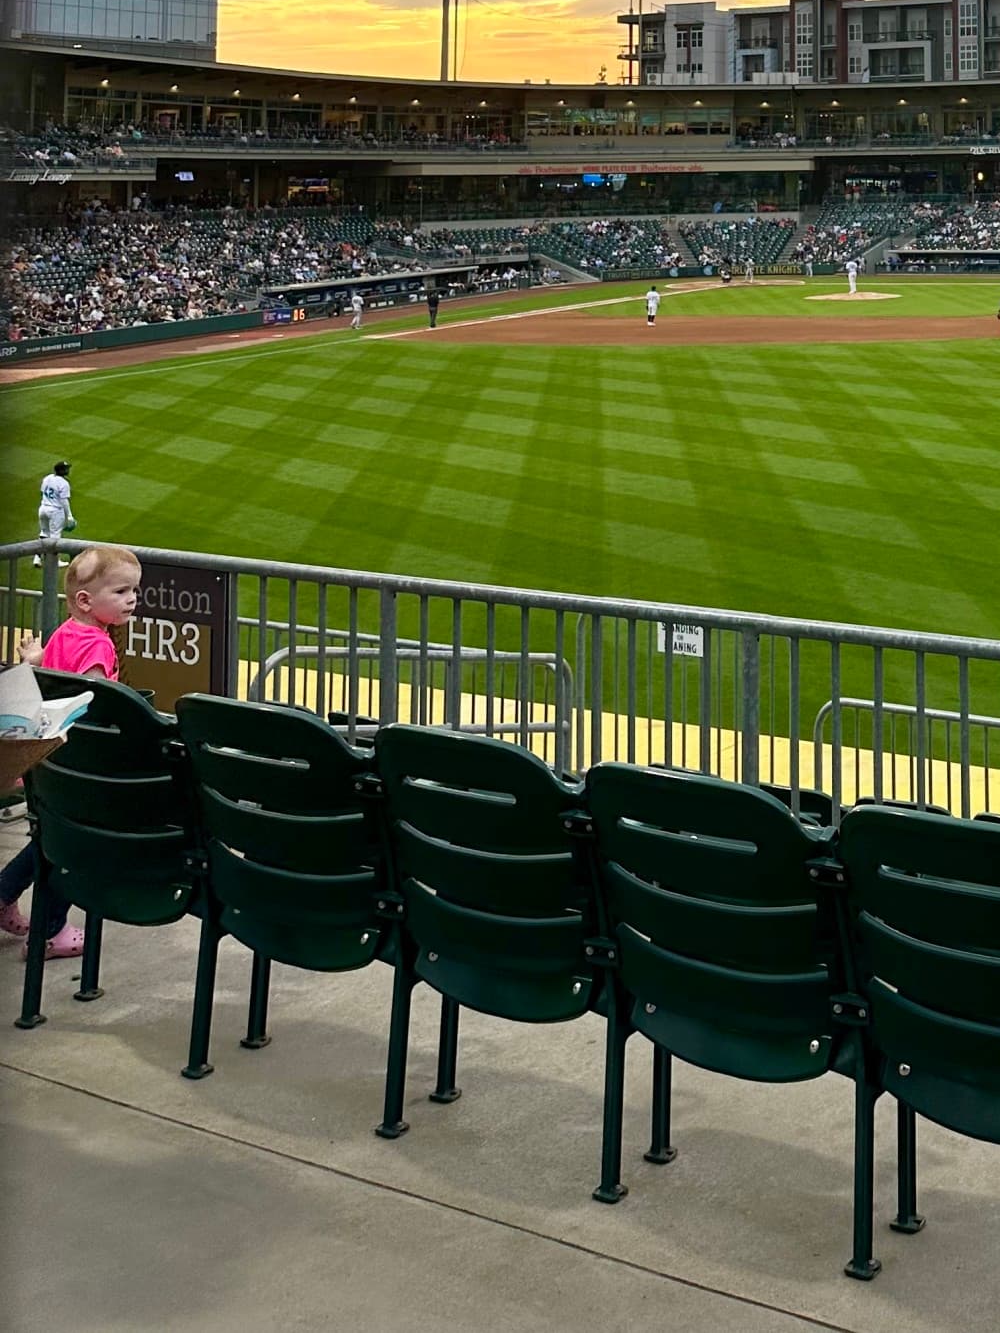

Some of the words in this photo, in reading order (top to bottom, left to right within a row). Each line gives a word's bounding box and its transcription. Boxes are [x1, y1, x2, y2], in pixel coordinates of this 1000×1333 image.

[767, 265, 802, 274] KNIGHTS
[136, 579, 212, 615] ection
[125, 615, 200, 665] HR3
